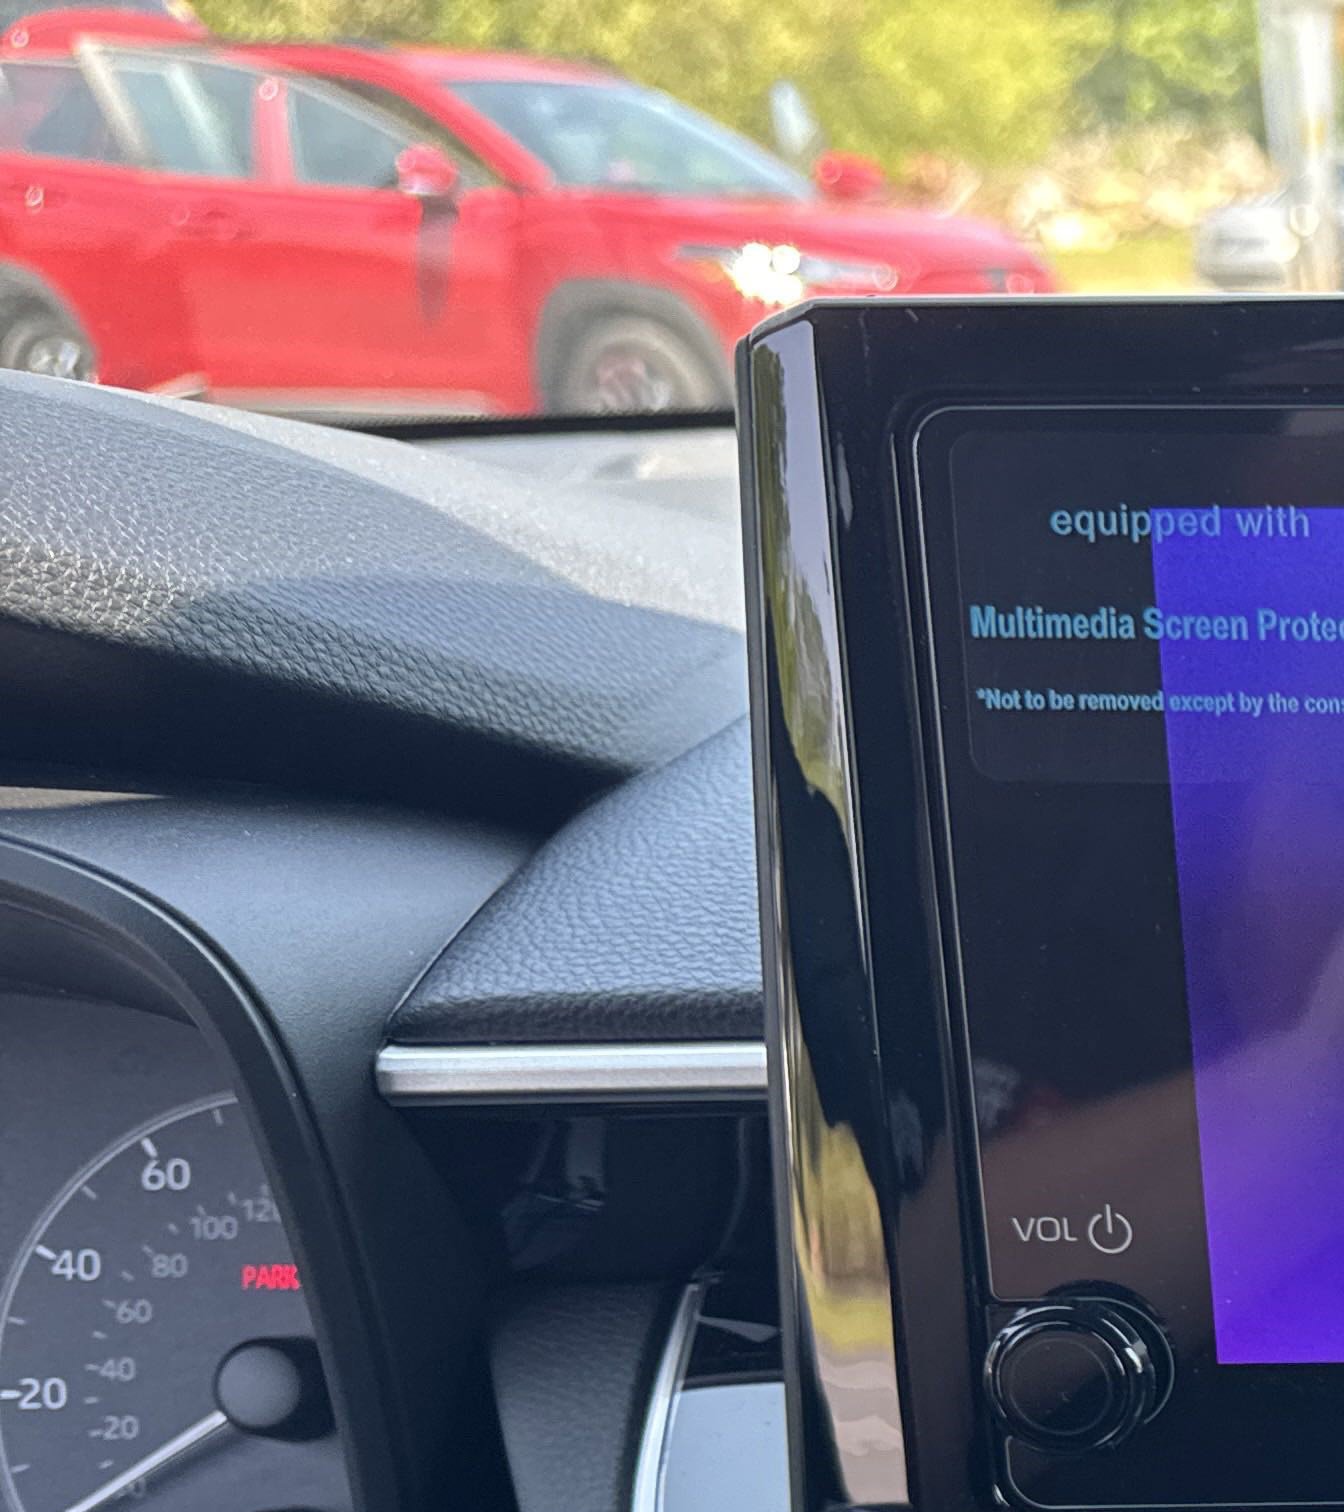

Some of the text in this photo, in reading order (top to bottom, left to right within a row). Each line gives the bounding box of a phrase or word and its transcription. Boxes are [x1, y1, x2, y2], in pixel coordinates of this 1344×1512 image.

[1050, 503, 1310, 543] equipped with
[969, 606, 1135, 640] Multimedia
[1143, 608, 1249, 640] Screen
[1025, 690, 1045, 710] to
[1049, 690, 1074, 710] be
[1078, 690, 1164, 711] removed
[1169, 694, 1235, 717] except
[1239, 692, 1264, 717] by
[1268, 692, 1299, 713] the
[141, 1157, 191, 1191] 60
[190, 1215, 237, 1240] 100
[1012, 1217, 1078, 1241] VOL
[51, 1249, 101, 1281] 40
[152, 1253, 188, 1278] 80
[242, 1264, 300, 1290] PARK
[116, 1299, 153, 1323] 60
[99, 1357, 136, 1382] 40
[18, 1377, 67, 1410] 20
[103, 1415, 139, 1440] 20
